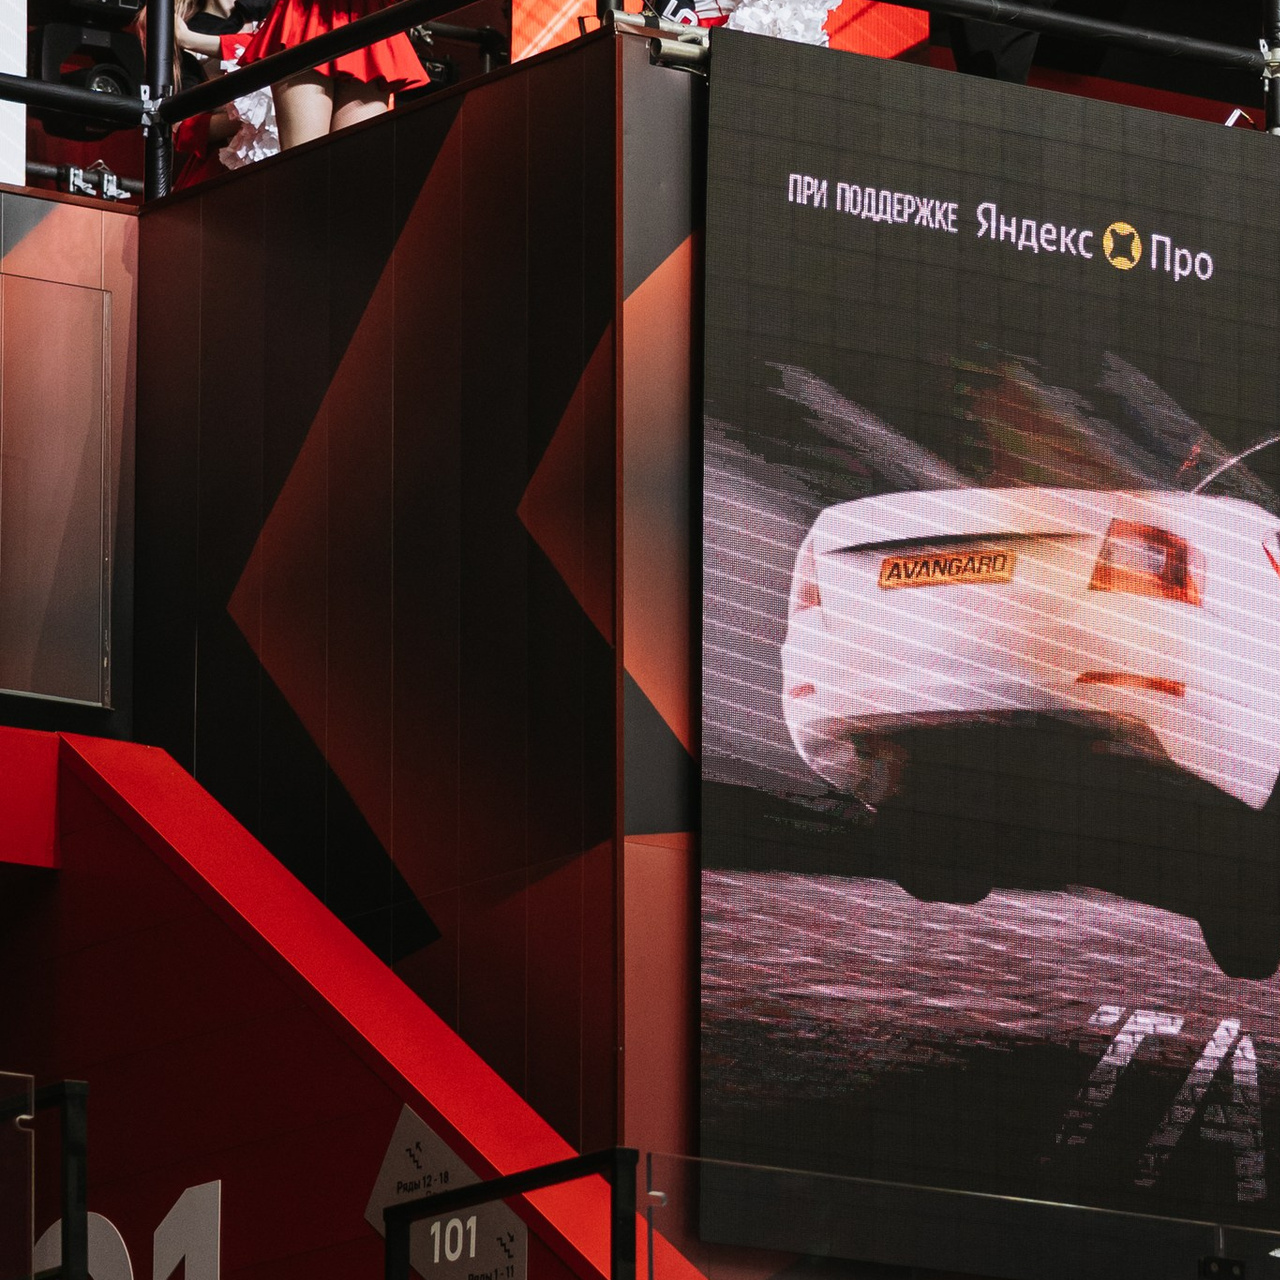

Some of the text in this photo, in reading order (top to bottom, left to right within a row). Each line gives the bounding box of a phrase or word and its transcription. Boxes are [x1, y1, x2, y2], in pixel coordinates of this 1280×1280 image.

[788, 173, 1214, 282] ПРИ ПОДДЕРЖКЕ Яндекс Про
[887, 553, 1008, 581] AVANGARD
[430, 1215, 477, 1264] 101
